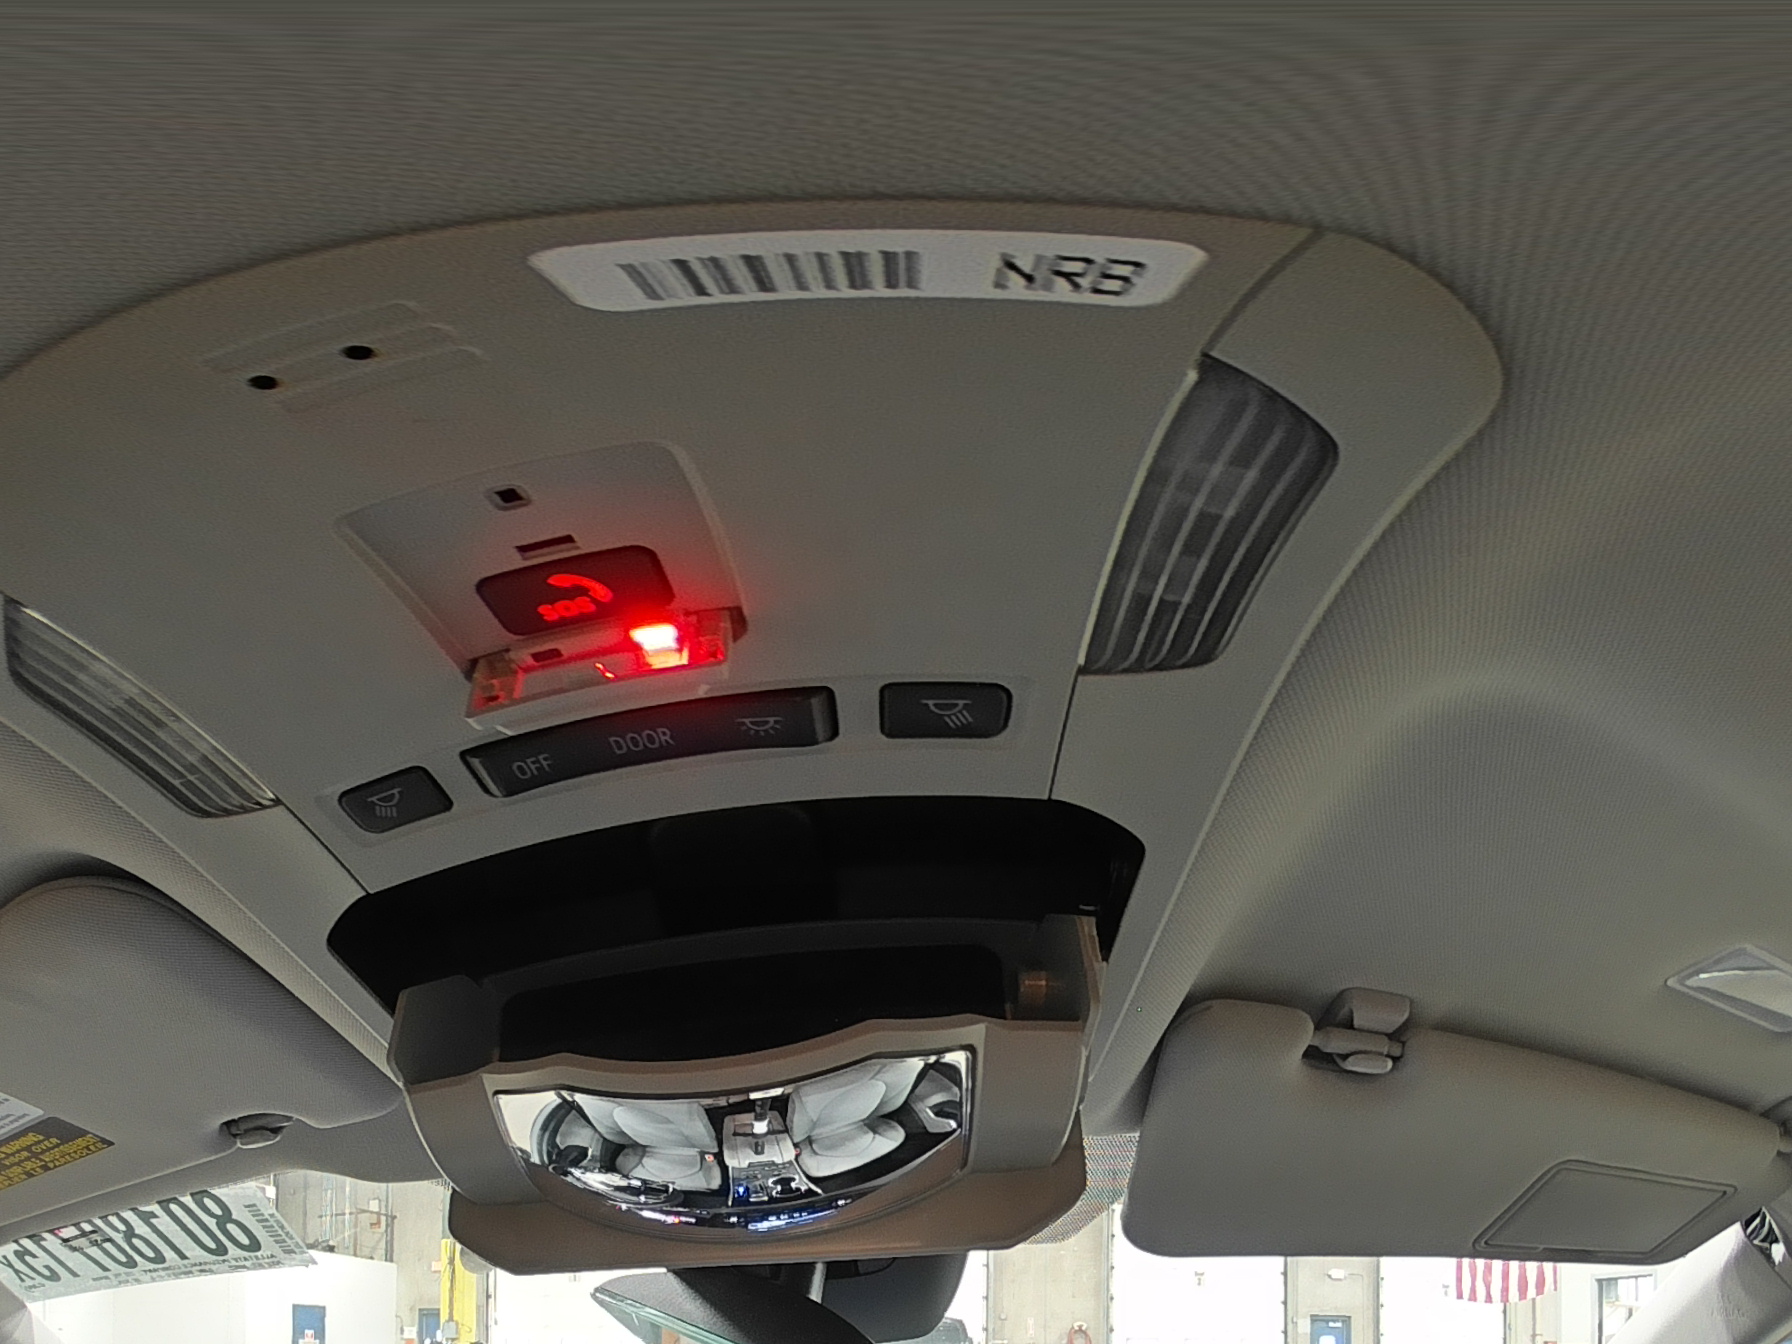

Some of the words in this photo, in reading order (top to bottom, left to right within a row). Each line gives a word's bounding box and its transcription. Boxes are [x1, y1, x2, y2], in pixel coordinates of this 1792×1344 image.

[993, 251, 1148, 297] NRB
[537, 596, 597, 623] SOS
[512, 754, 554, 780] OFF
[608, 727, 675, 755] DOOR
